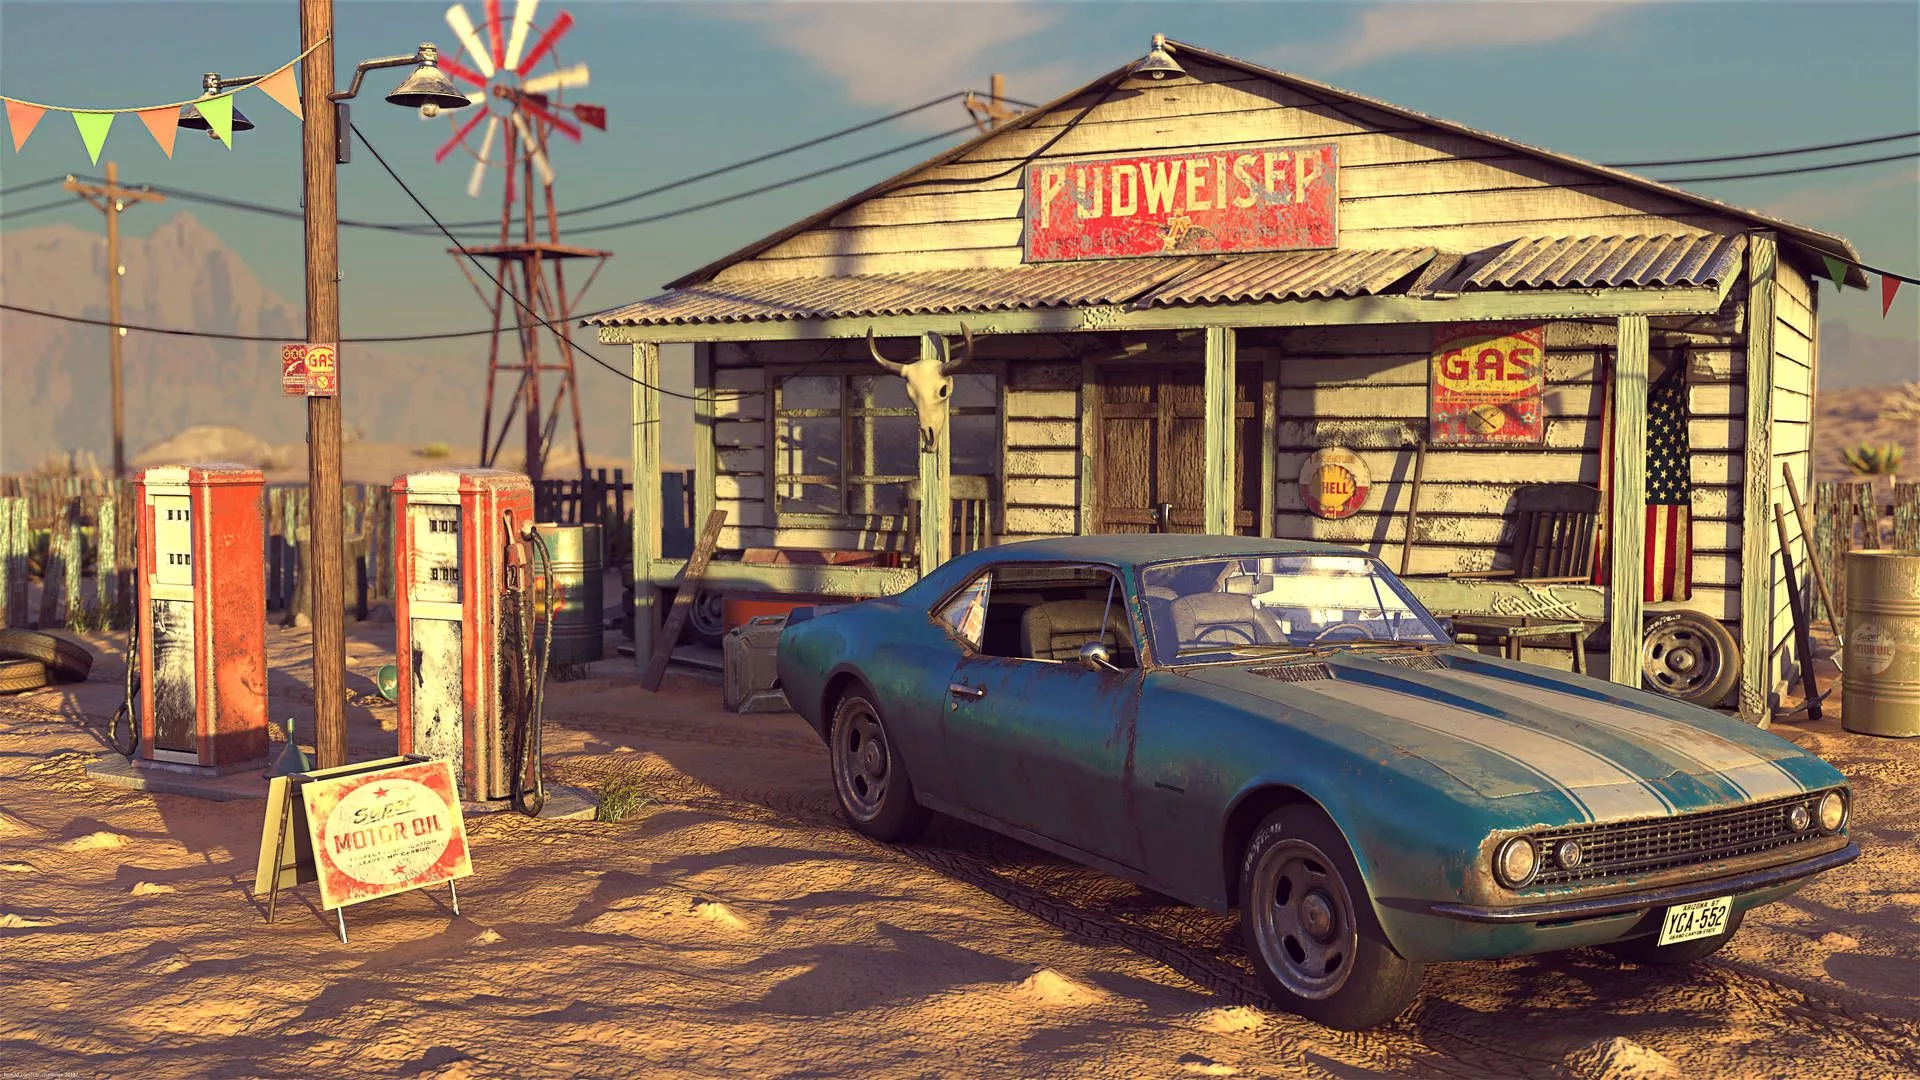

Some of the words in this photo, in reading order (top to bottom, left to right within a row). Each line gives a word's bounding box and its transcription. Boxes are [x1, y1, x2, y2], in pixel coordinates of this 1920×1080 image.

[309, 353, 334, 368] GAS
[1440, 348, 1534, 380] GAS
[353, 796, 416, 825] Super
[334, 821, 409, 854] MOTOR
[412, 814, 443, 837] OIL
[1669, 906, 1726, 935] YCA-552
[1683, 902, 1709, 911] ARIZONA
